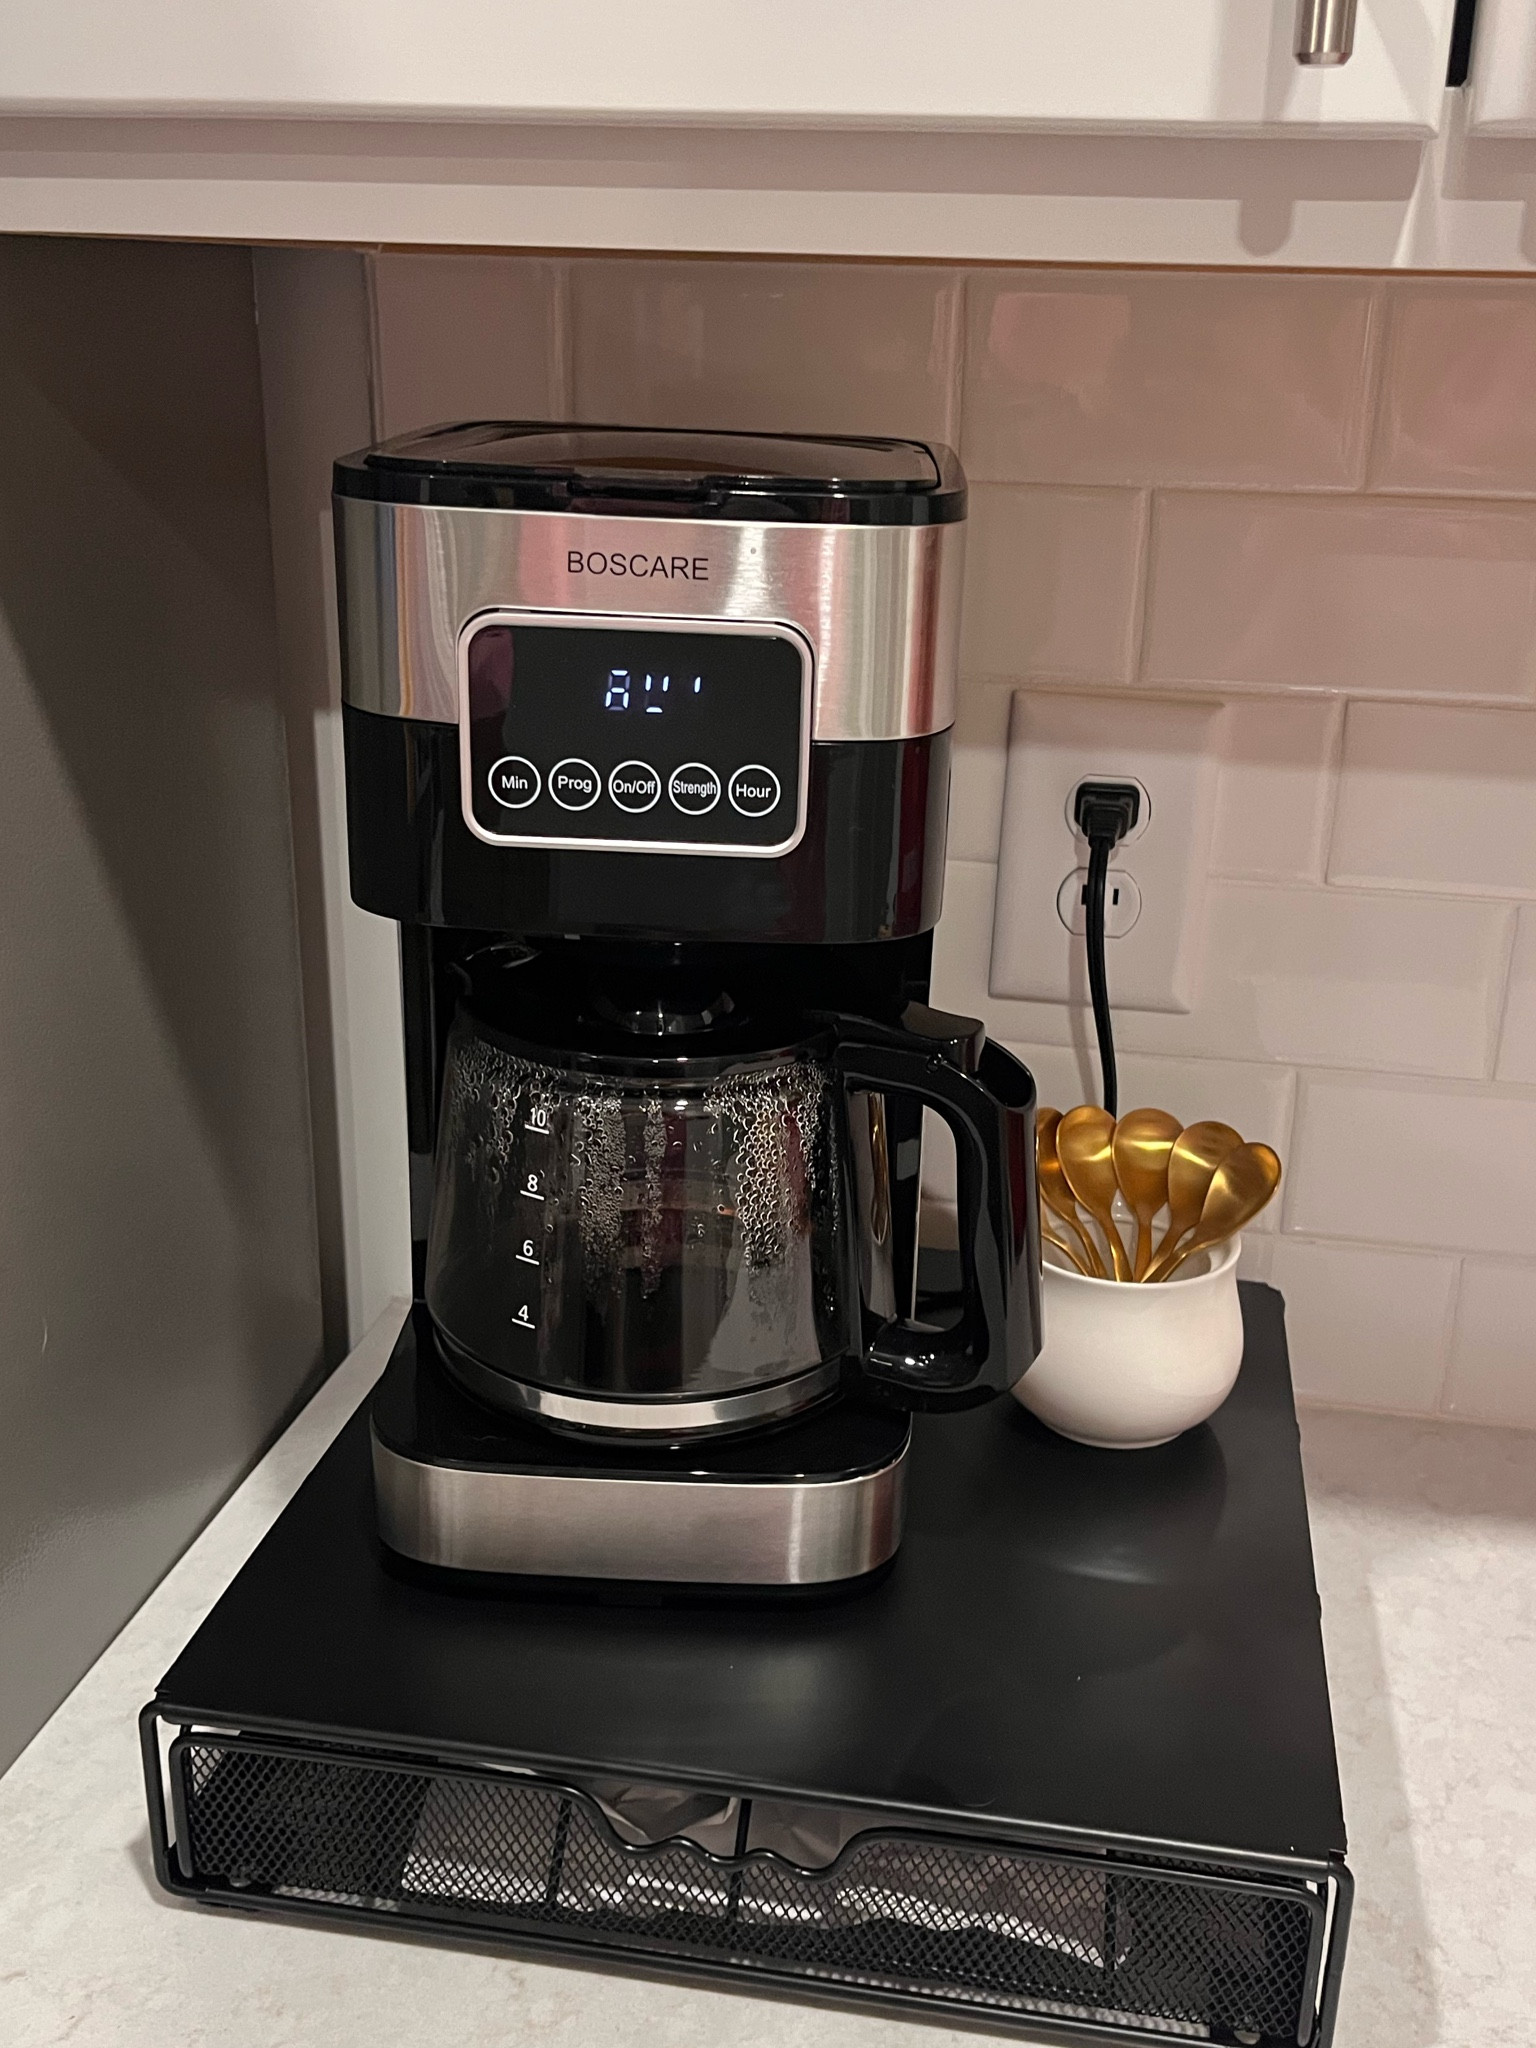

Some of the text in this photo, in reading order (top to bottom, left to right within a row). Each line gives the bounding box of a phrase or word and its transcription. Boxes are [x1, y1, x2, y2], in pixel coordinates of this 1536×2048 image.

[567, 550, 710, 581] BOSCARE
[501, 775, 528, 790] Min
[557, 776, 592, 794] Prog
[612, 779, 656, 795] On/Off
[672, 779, 717, 798] Strength
[735, 783, 772, 798] Hour
[530, 1107, 547, 1127] 10
[526, 1173, 539, 1192] 8
[522, 1239, 534, 1257] 6
[517, 1304, 529, 1321] 4
